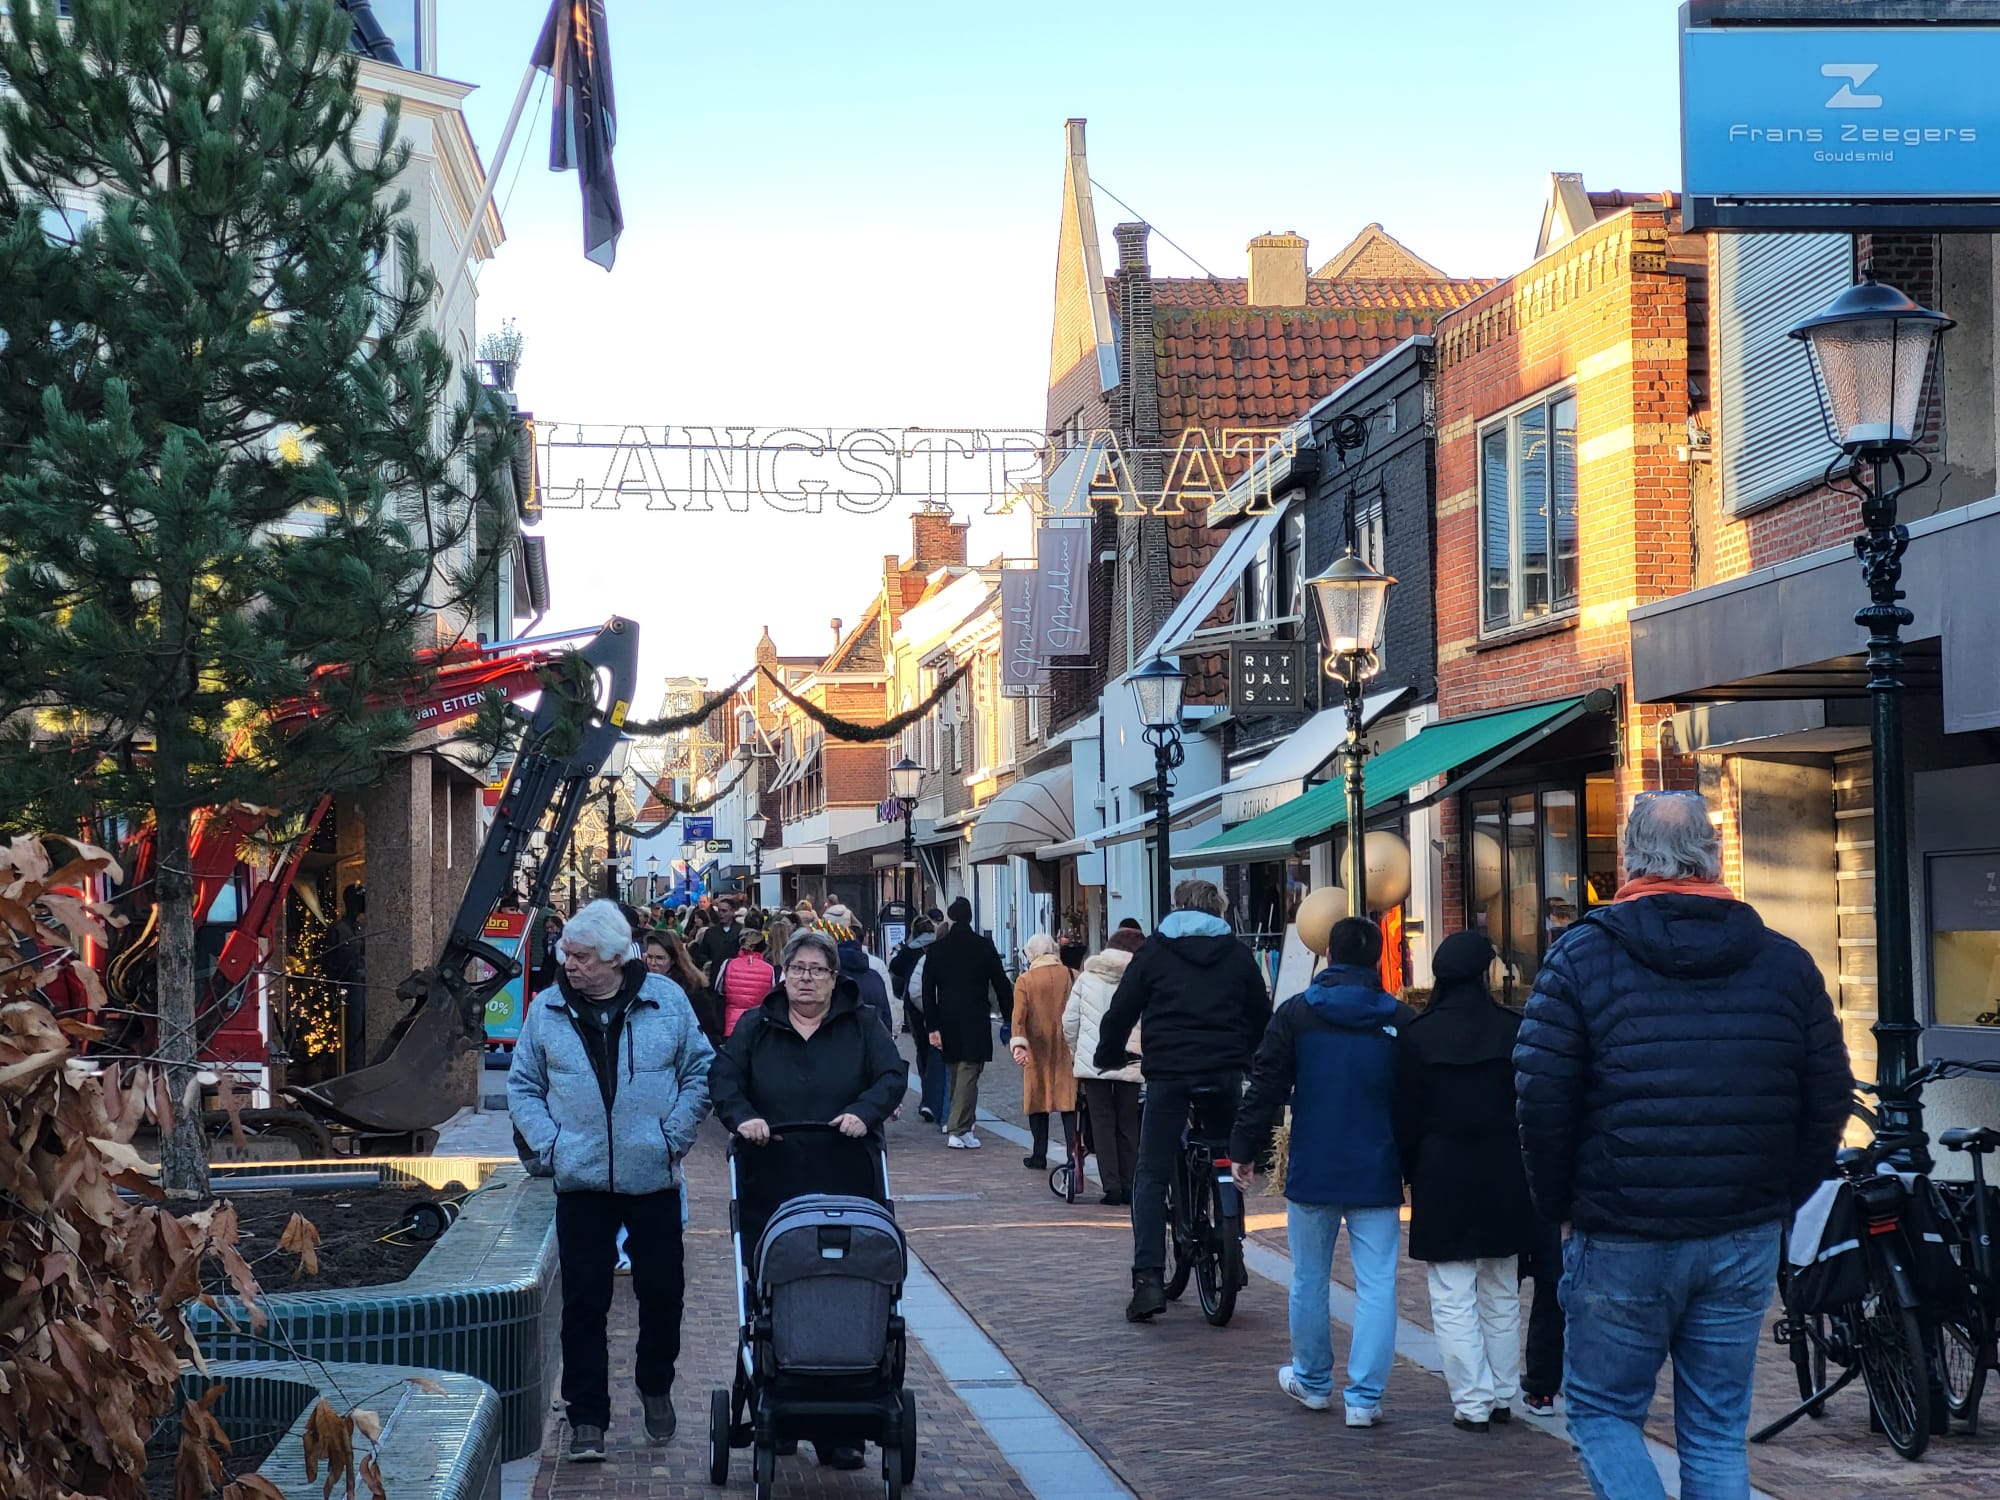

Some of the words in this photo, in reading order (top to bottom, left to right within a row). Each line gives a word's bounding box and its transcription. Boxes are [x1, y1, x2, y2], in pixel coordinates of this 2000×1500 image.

[1729, 124, 1823, 142] Frans
[1840, 124, 1977, 146] Zeegers
[1813, 150, 1894, 162] Goudsmid
[524, 420, 1298, 517] LANGSTRAAT
[1047, 536, 1081, 648] Madeleine
[1010, 576, 1040, 678] Madeleine
[416, 707, 438, 720] van
[485, 1000, 508, 1015] 0%
